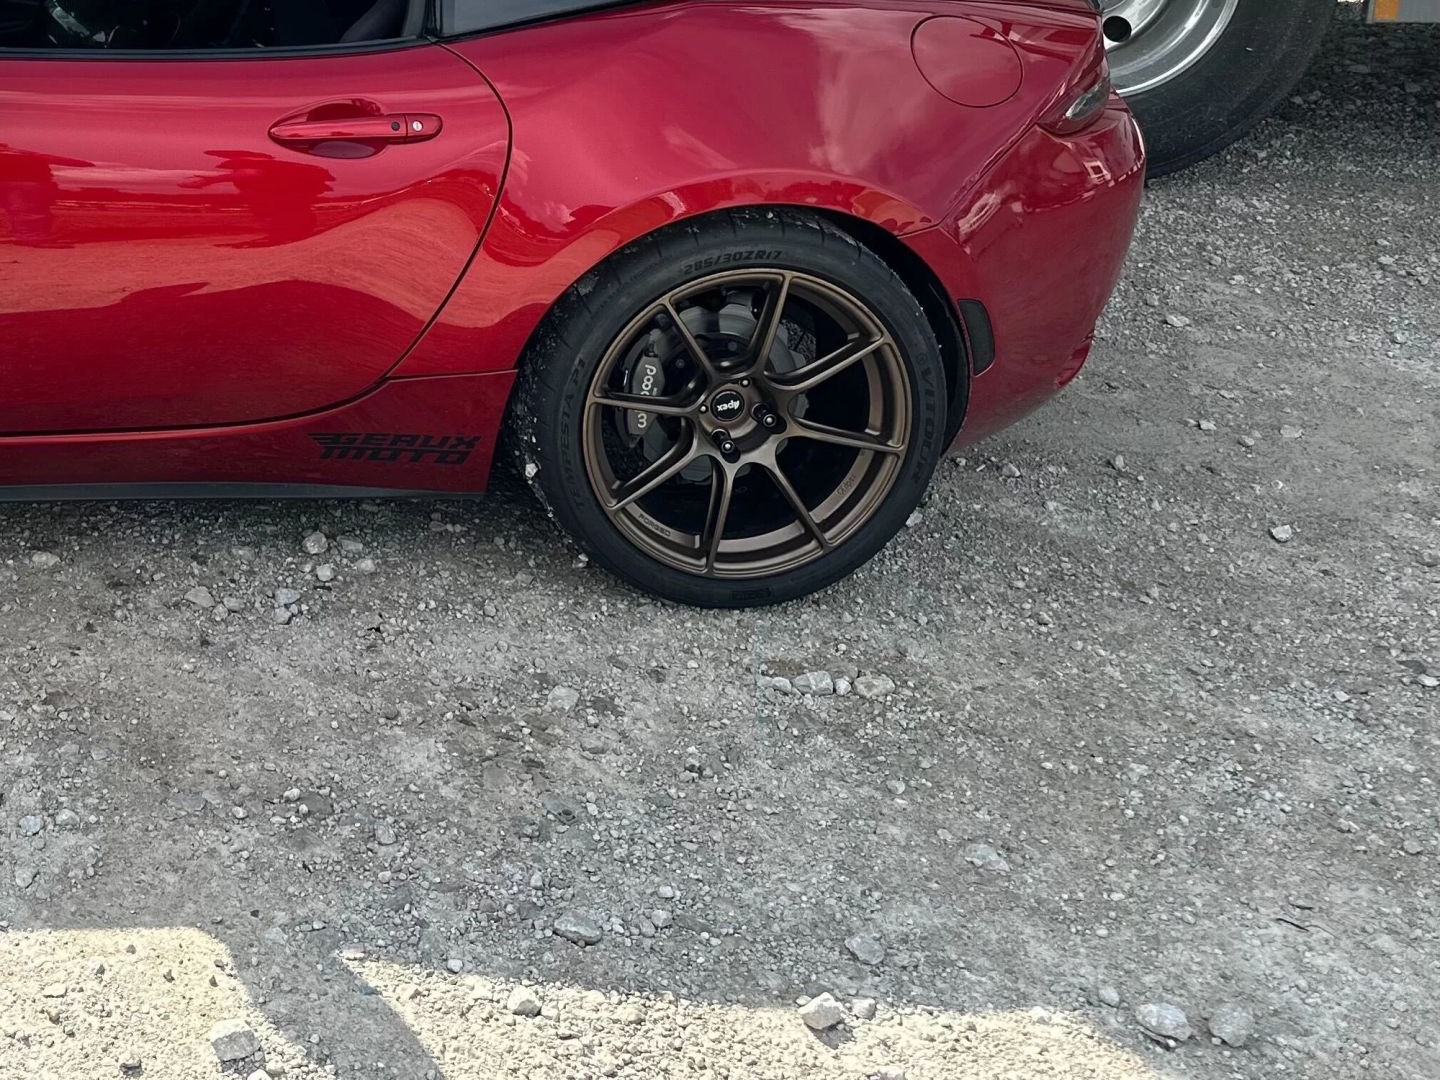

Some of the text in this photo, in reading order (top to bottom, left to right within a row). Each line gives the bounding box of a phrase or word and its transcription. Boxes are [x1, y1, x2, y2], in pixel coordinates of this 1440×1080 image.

[312, 433, 482, 451] GEAUX
[319, 446, 472, 465] MOTO
[559, 393, 586, 510] TEMPESTA
[912, 366, 936, 486] VITOUR
